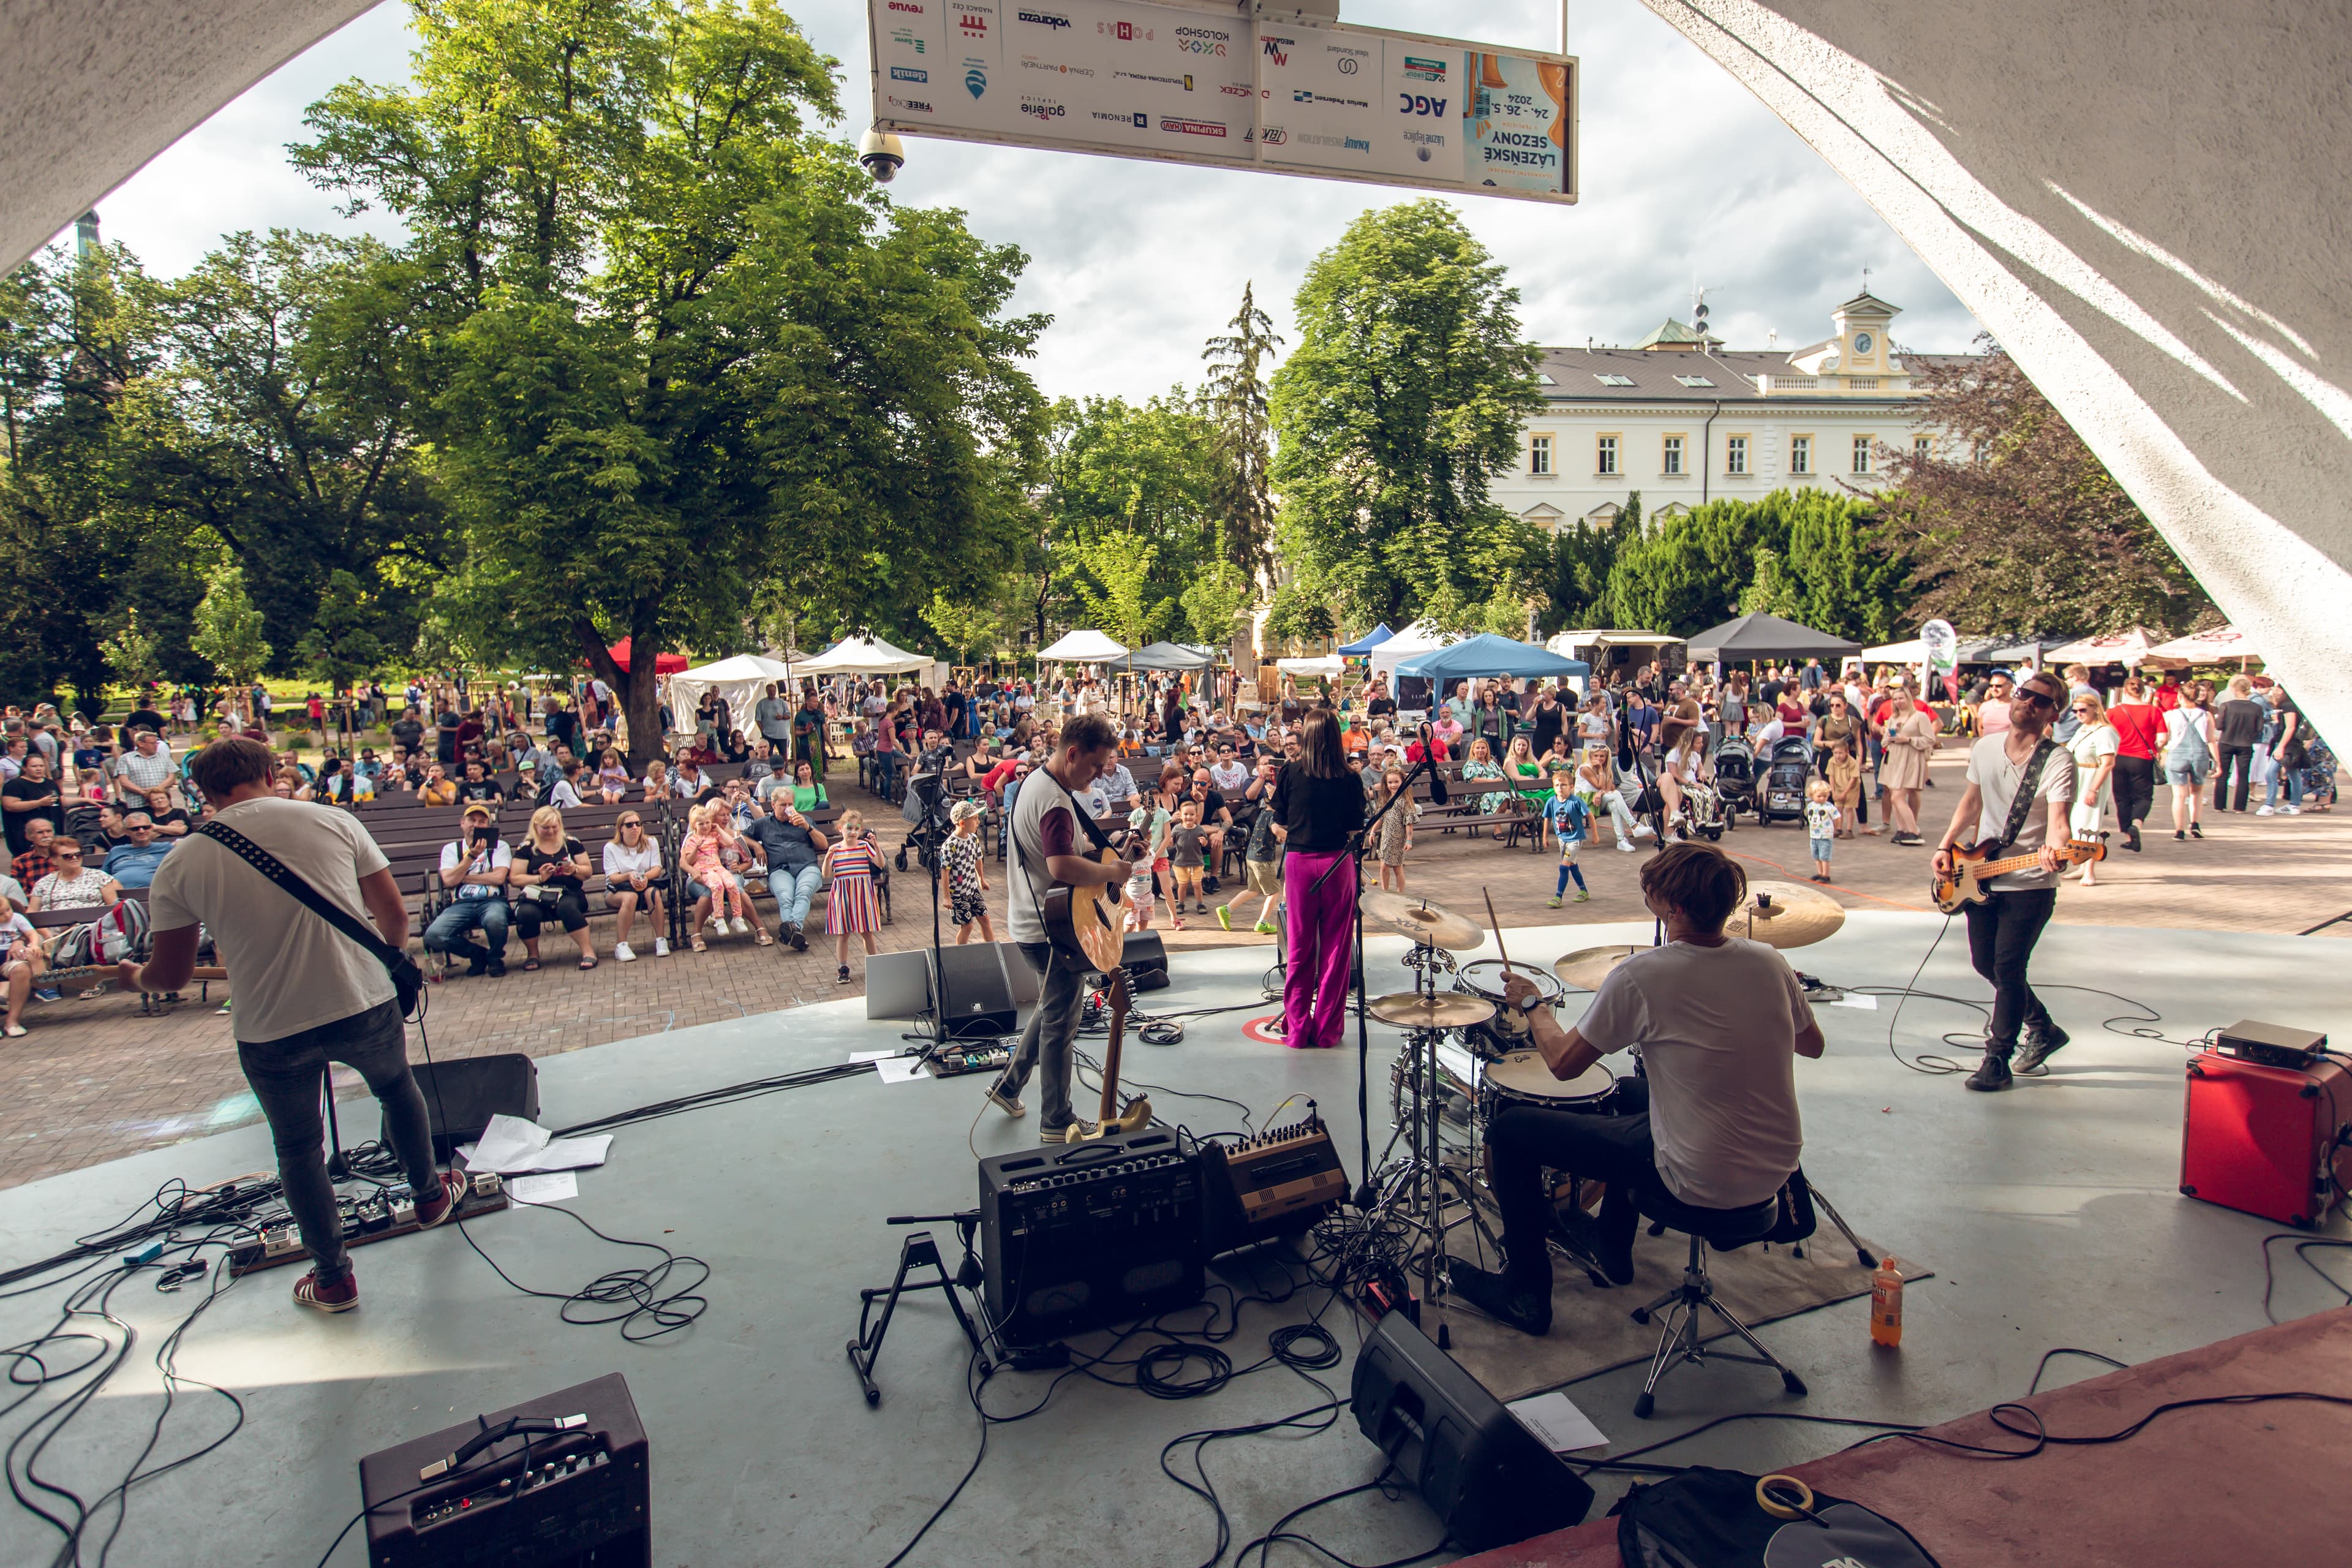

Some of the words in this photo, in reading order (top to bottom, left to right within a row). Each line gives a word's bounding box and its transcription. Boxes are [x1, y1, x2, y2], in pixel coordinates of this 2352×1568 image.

[888, 2, 924, 14] revue
[952, 3, 964, 12] ČEZ
[966, 5, 993, 14] NADACE
[1019, 12, 1071, 30] volareza
[1096, 21, 1153, 41] POHAS
[1175, 26, 1229, 41] KOLOSHOP
[1327, 45, 1353, 56] Standard
[1021, 61, 1058, 71] PARTNEŘI
[892, 69, 926, 81] deník
[1068, 67, 1094, 77] ČERNÁ
[891, 99, 930, 110] FREEČKO
[1021, 96, 1056, 104] TEPLICE
[1314, 95, 1344, 105] Pedersen
[1347, 99, 1368, 108] Marius
[1507, 94, 1532, 105] 2024
[1400, 93, 1447, 118] AGC
[1491, 103, 1501, 113] 5.
[1504, 104, 1520, 116] 26.
[1092, 111, 1131, 123] RENOMIA
[1531, 108, 1548, 119] 24.
[1183, 124, 1224, 135] SKUPINA
[1491, 132, 1547, 149] SEZONY
[1484, 147, 1555, 168] LÁZEŇSKÉ
